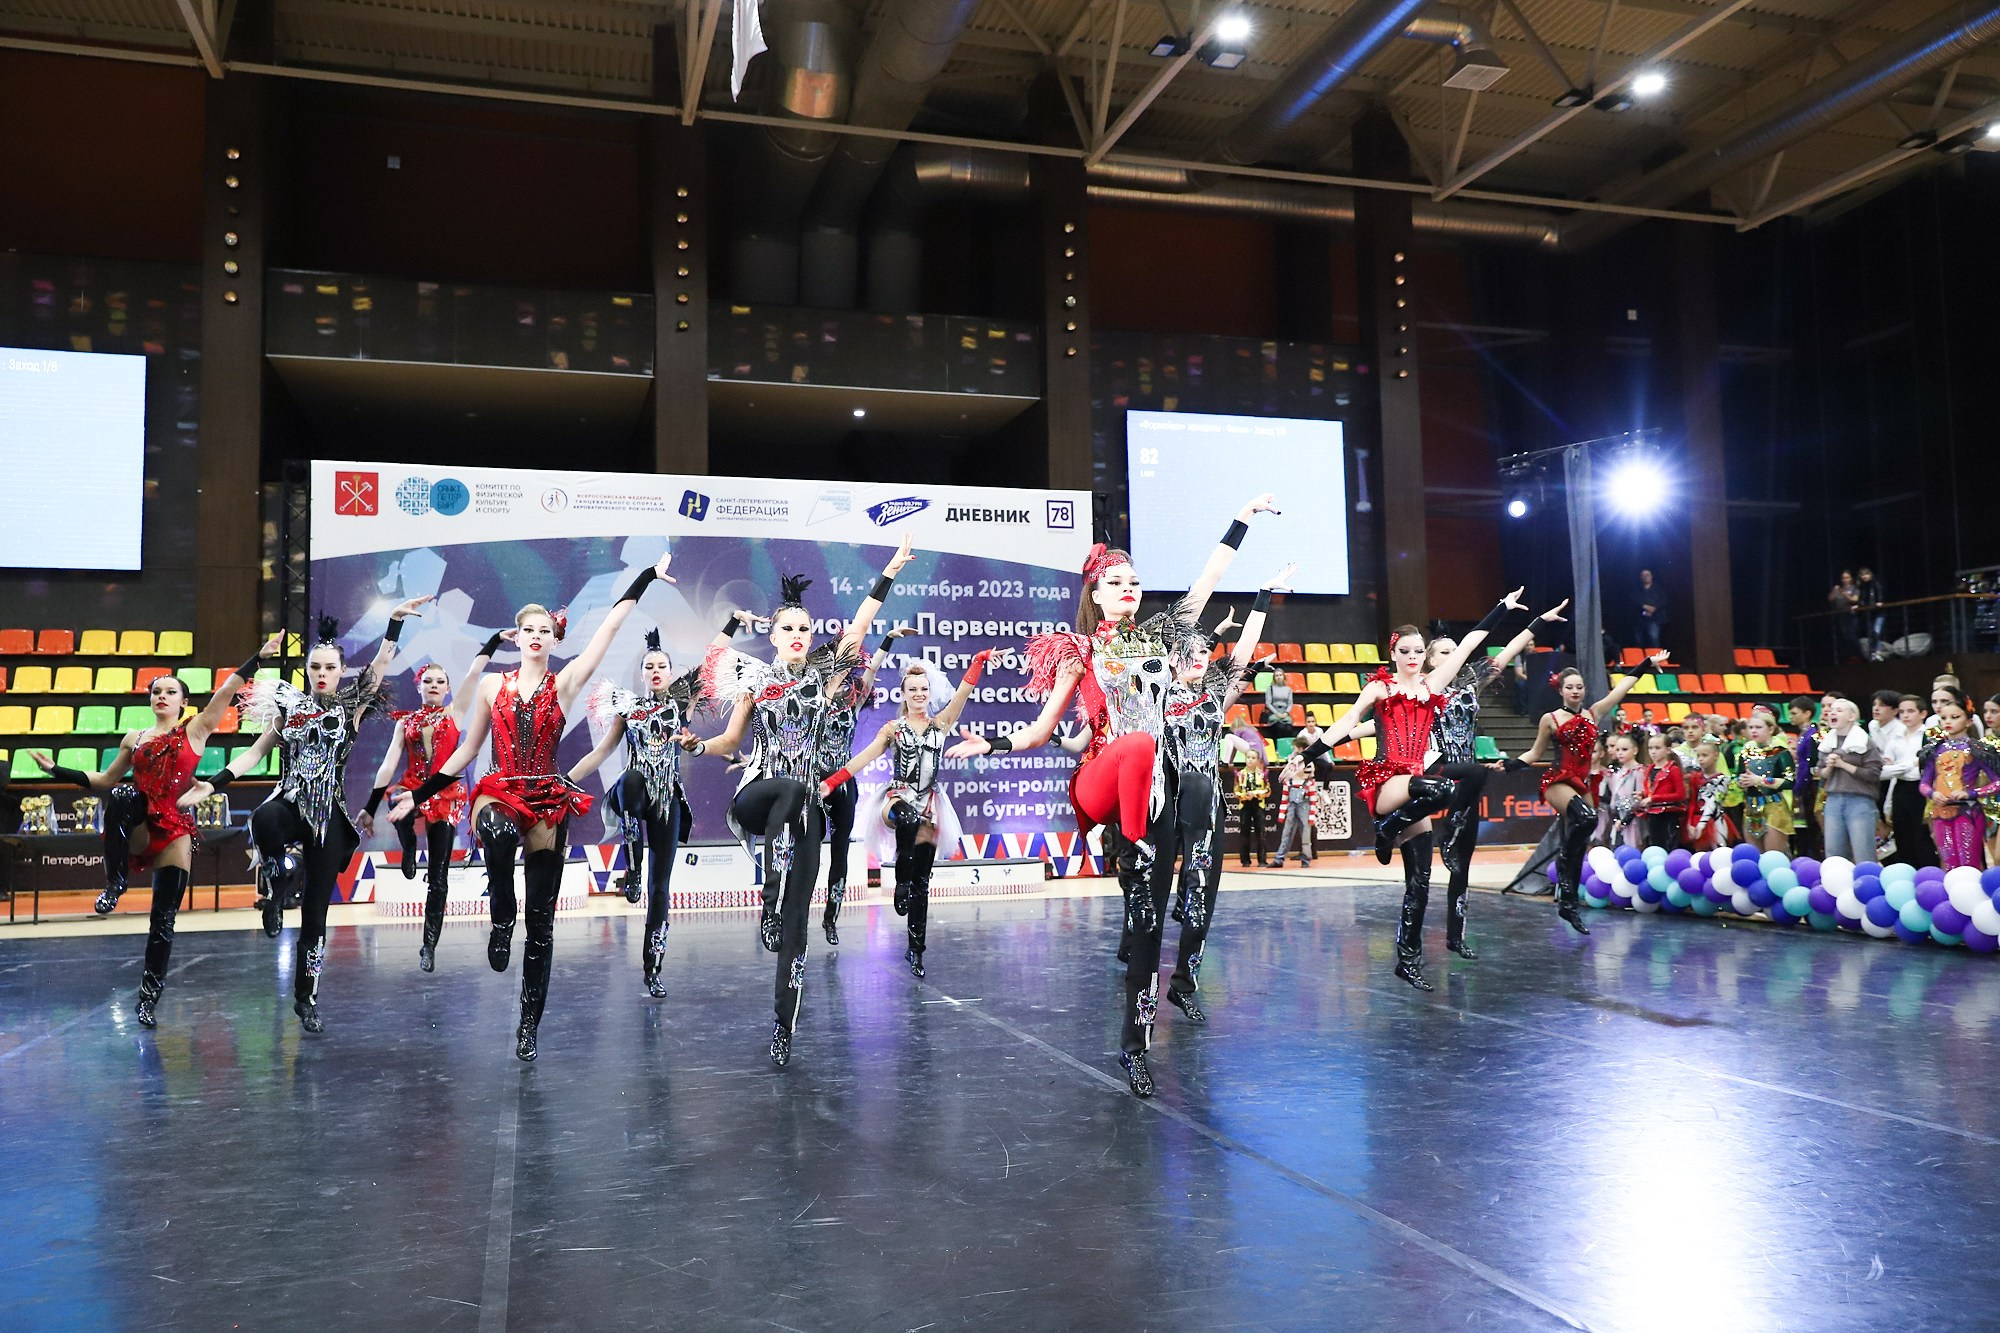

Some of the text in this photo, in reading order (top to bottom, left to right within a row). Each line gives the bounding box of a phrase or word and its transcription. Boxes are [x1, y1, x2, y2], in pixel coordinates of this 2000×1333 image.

[716, 506, 789, 516] ФЕДЕРАЦИЯ
[945, 508, 1031, 523] ДНЕВНИК
[1051, 507, 1069, 522] 78
[830, 577, 852, 595] 14
[893, 580, 973, 600] октября
[978, 580, 1024, 598] 2023
[1029, 586, 1071, 600] года
[917, 612, 1071, 641] Первенство
[974, 752, 1076, 774] фестиваль
[966, 800, 1076, 820] и буги-вуги
[970, 868, 980, 885] 3
